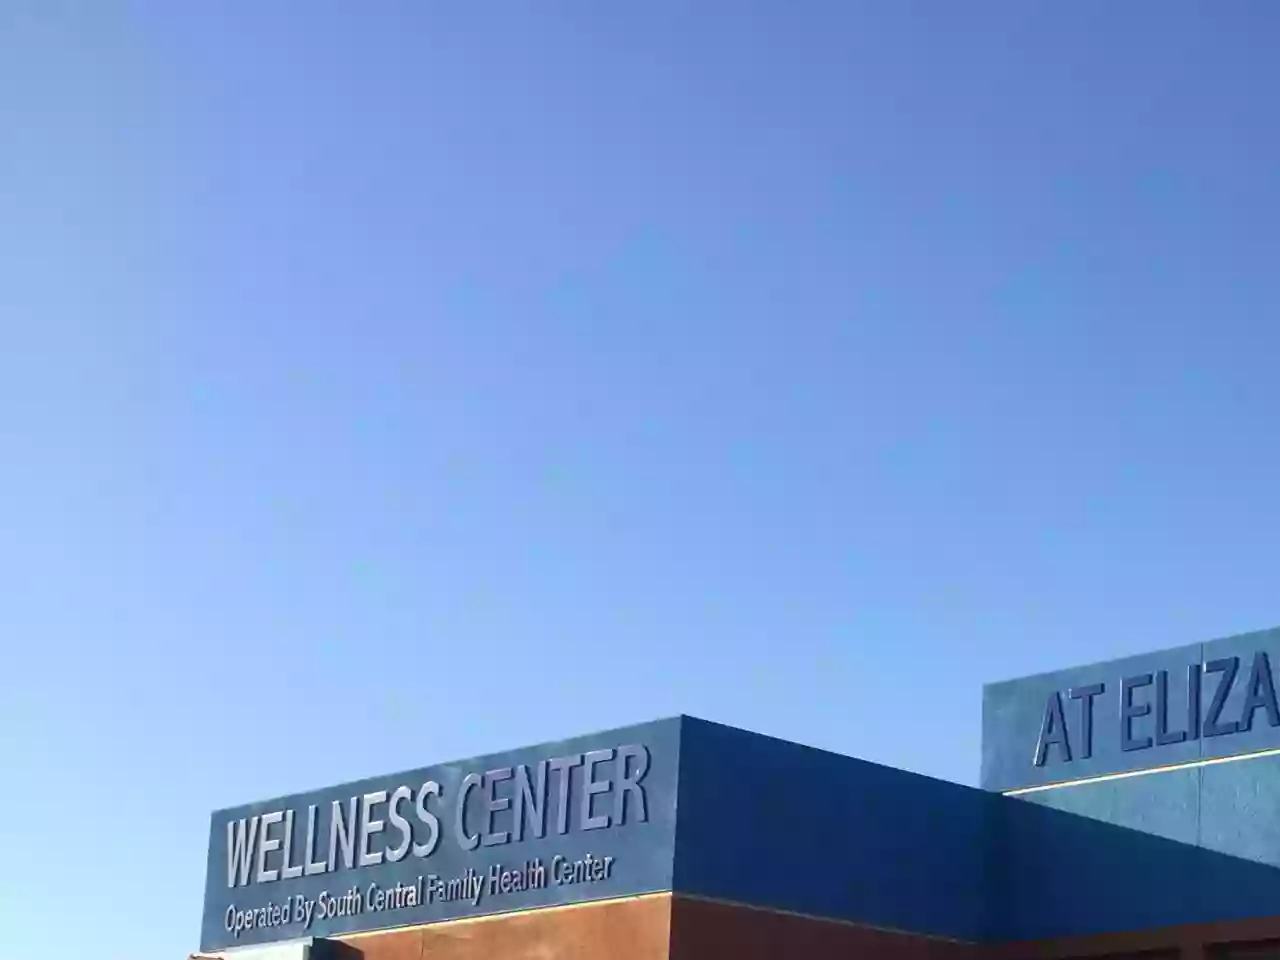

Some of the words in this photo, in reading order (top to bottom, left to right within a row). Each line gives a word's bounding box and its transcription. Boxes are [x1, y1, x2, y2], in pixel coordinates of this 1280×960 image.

[1034, 683, 1105, 766] AT
[226, 781, 443, 888] WELLNESS
[455, 744, 652, 851] CENTER
[225, 901, 293, 936] Operated
[296, 894, 315, 929] By
[318, 885, 361, 918] South
[366, 876, 424, 911] Central
[428, 867, 484, 907] Family
[488, 864, 549, 896] Health
[551, 854, 614, 883] Center
